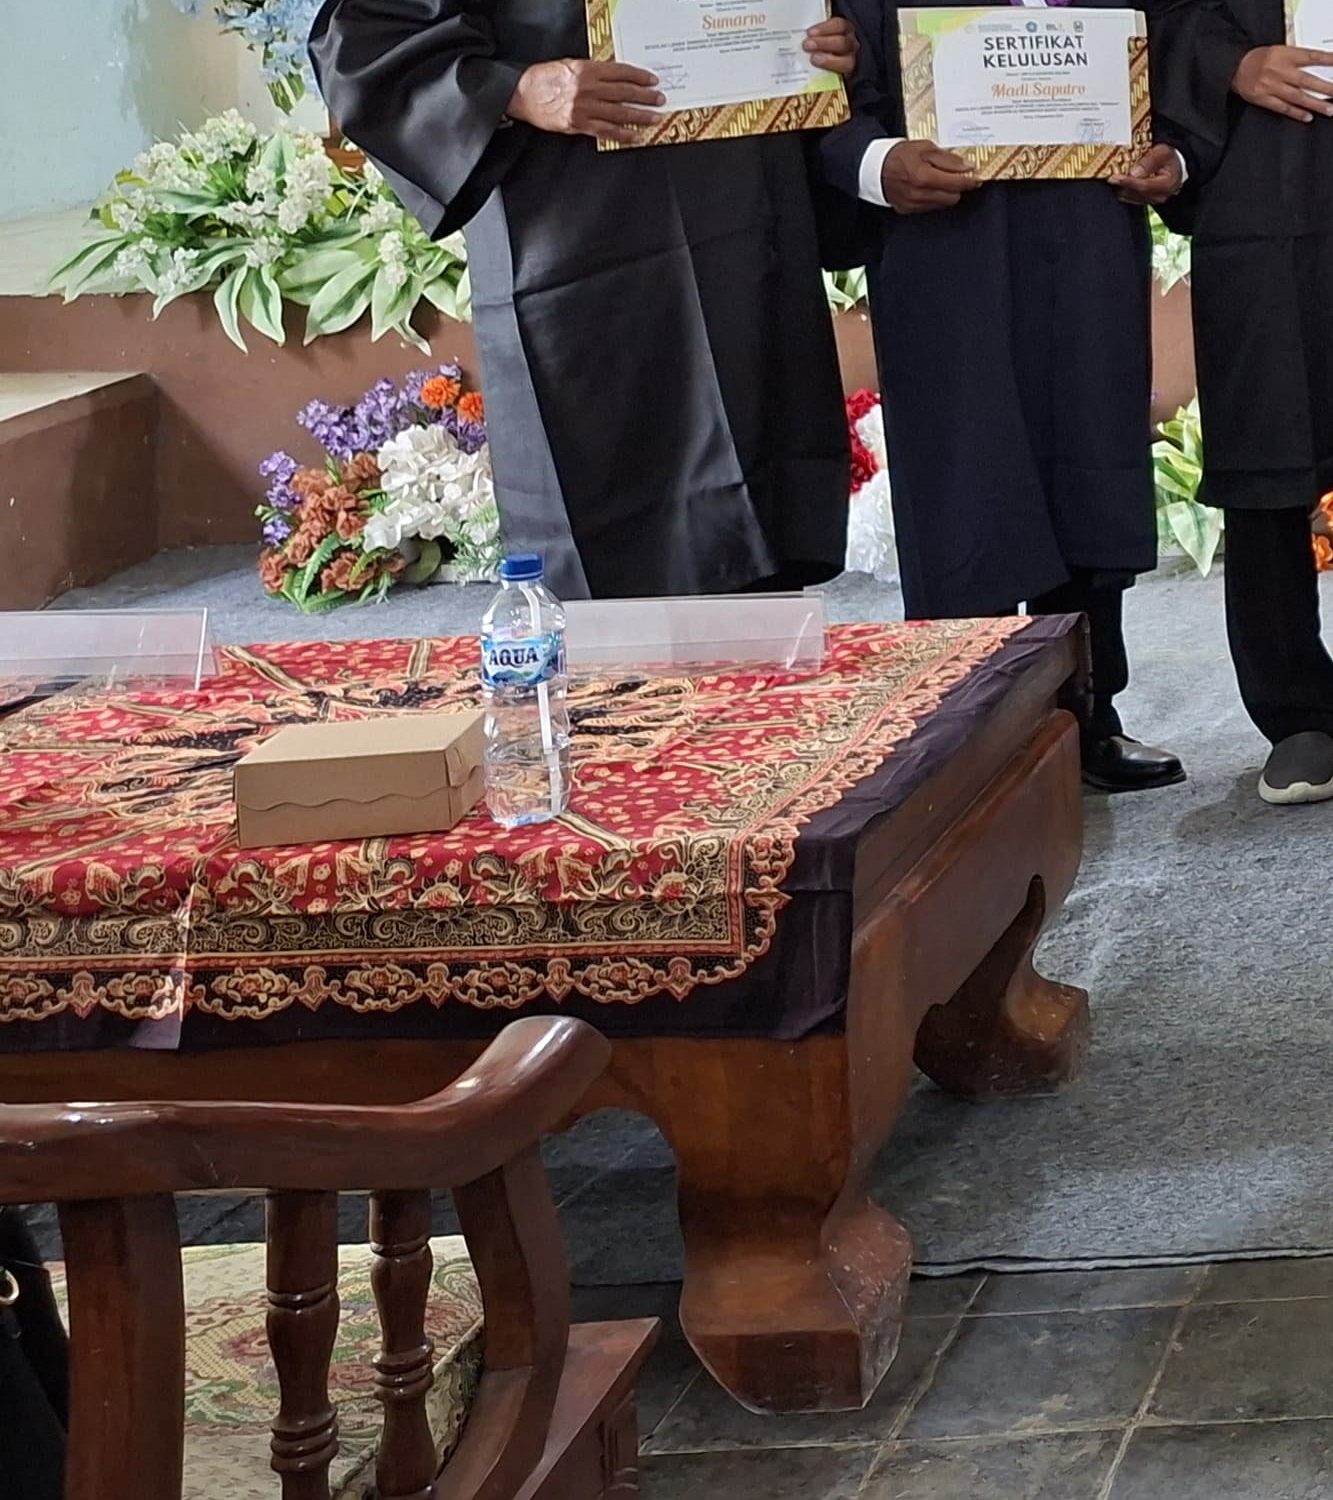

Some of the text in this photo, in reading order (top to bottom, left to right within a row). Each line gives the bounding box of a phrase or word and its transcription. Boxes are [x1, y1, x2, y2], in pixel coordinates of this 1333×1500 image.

[702, 13, 766, 31] Sumarno
[984, 35, 1084, 51] SERTIFIKAT
[983, 52, 1088, 68] KELULUSAN
[992, 82, 1086, 100] Madi Saputro
[489, 647, 540, 668] AQUA
